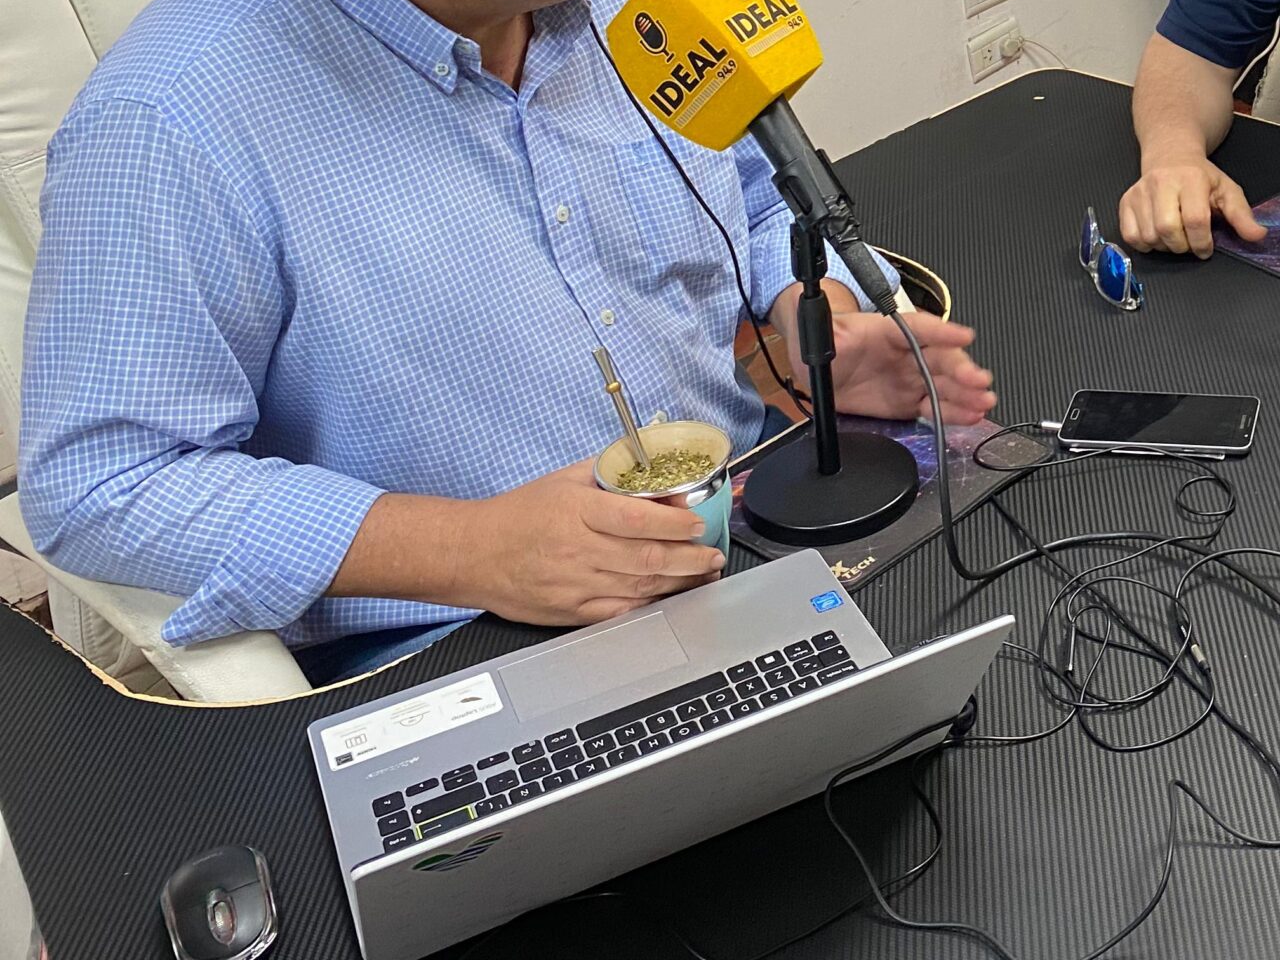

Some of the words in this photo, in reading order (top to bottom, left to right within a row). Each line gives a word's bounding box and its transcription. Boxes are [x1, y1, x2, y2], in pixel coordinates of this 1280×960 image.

[649, 38, 728, 117] IDEAL
[745, 682, 755, 691] X
[797, 681, 807, 689] A
[715, 693, 726, 702] C
[769, 693, 778, 701] S
[687, 705, 697, 713] V
[740, 704, 750, 712] D
[656, 716, 666, 724] B
[624, 728, 635, 737] N
[678, 727, 690, 735] G
[592, 739, 605, 749] M
[649, 739, 660, 748] H
[586, 763, 596, 772] K
